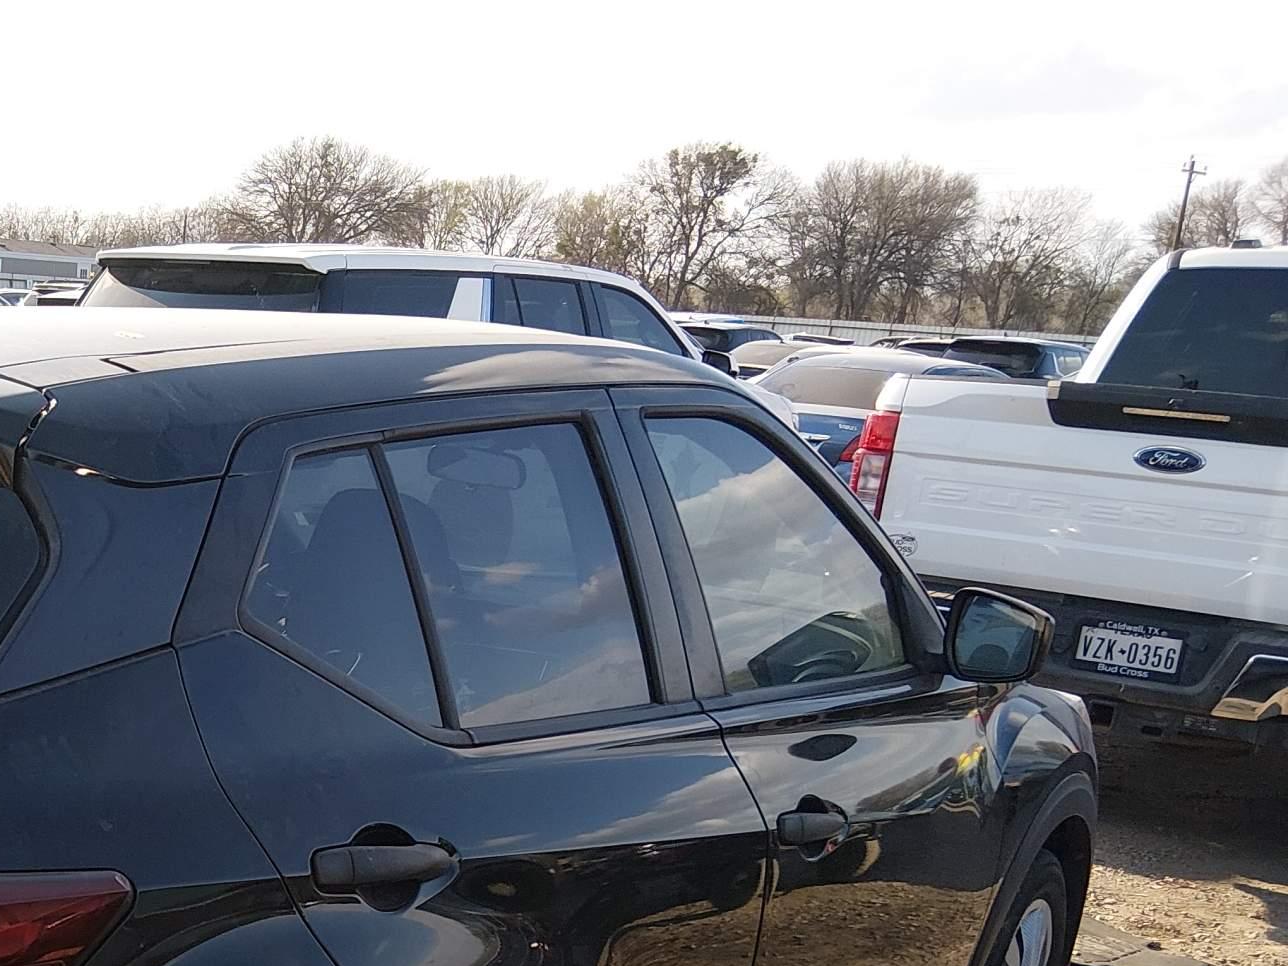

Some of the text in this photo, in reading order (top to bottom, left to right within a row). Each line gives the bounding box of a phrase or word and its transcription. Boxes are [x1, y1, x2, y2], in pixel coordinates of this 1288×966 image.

[1149, 450, 1189, 467] Ford
[1147, 626, 1161, 636] TX
[1097, 663, 1149, 678] Bud Cross
